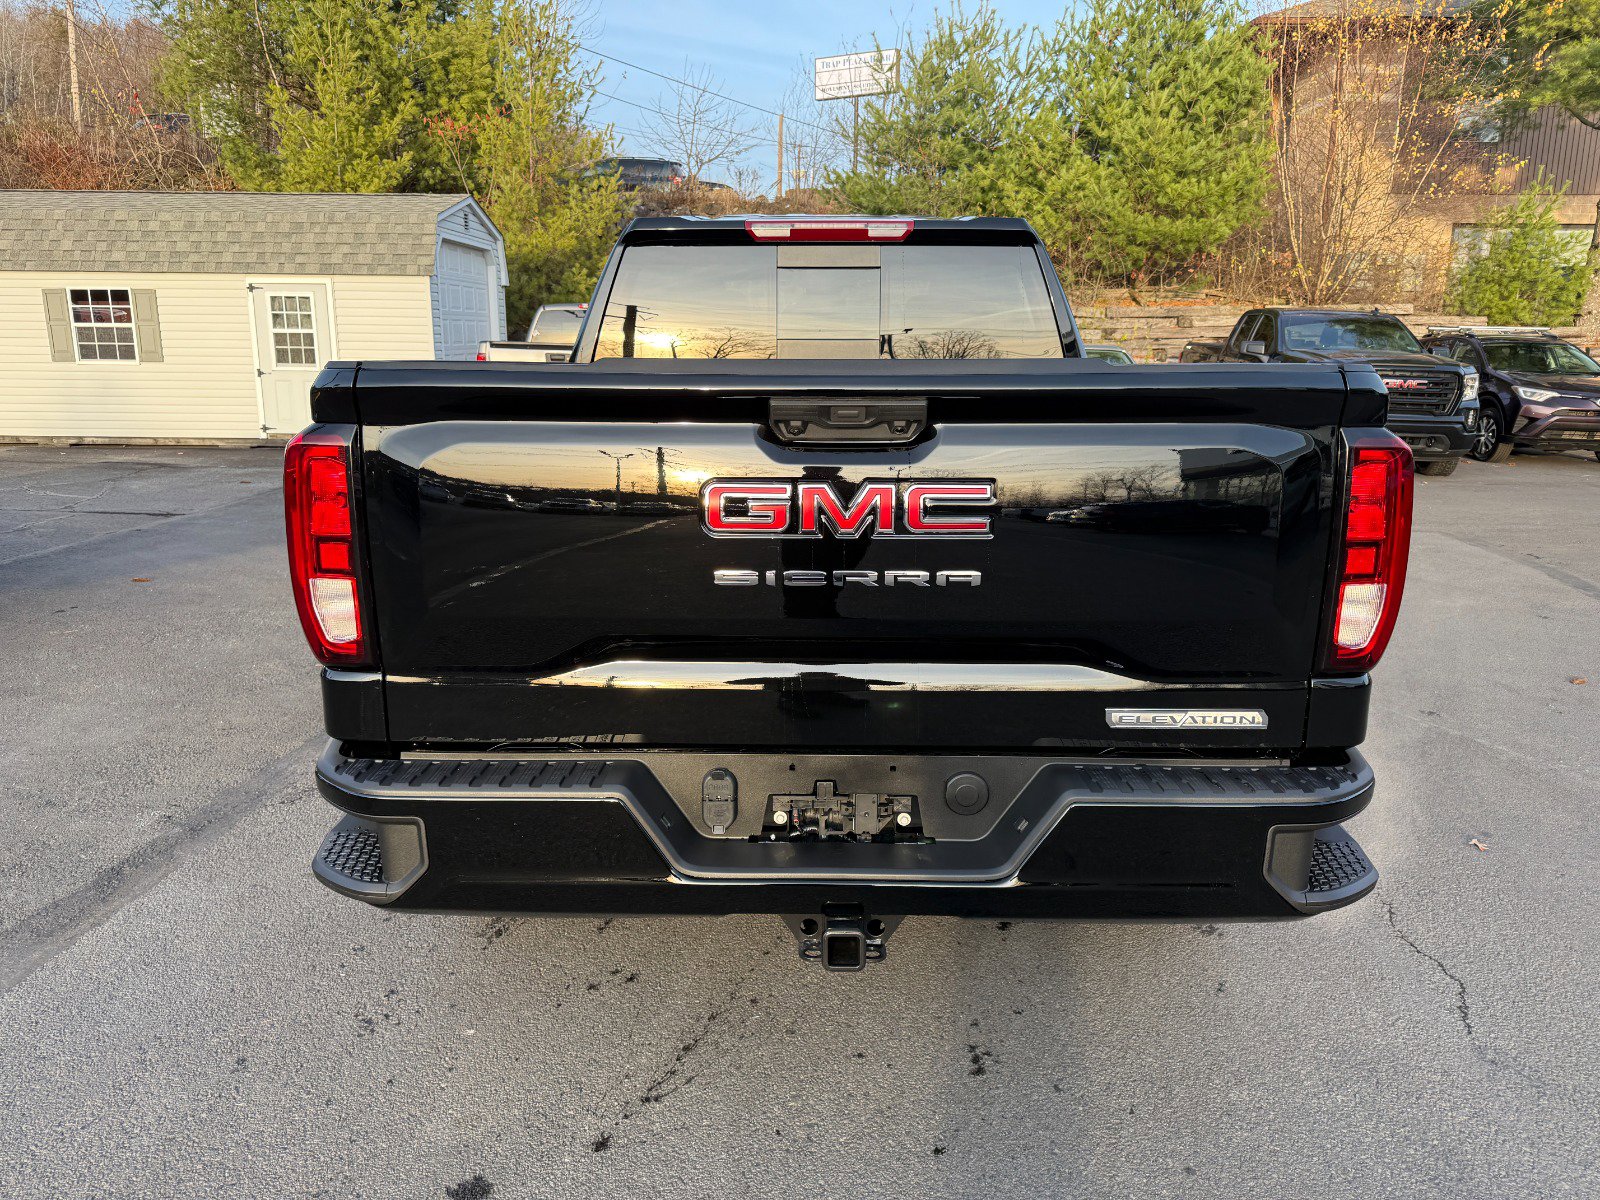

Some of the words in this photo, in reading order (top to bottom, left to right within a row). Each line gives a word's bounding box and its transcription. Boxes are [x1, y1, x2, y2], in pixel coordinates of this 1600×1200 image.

[1382, 378, 1429, 389] GMC
[700, 477, 997, 540] GMC
[713, 569, 982, 587] SIERRA
[1117, 714, 1257, 725] ELEVATION
